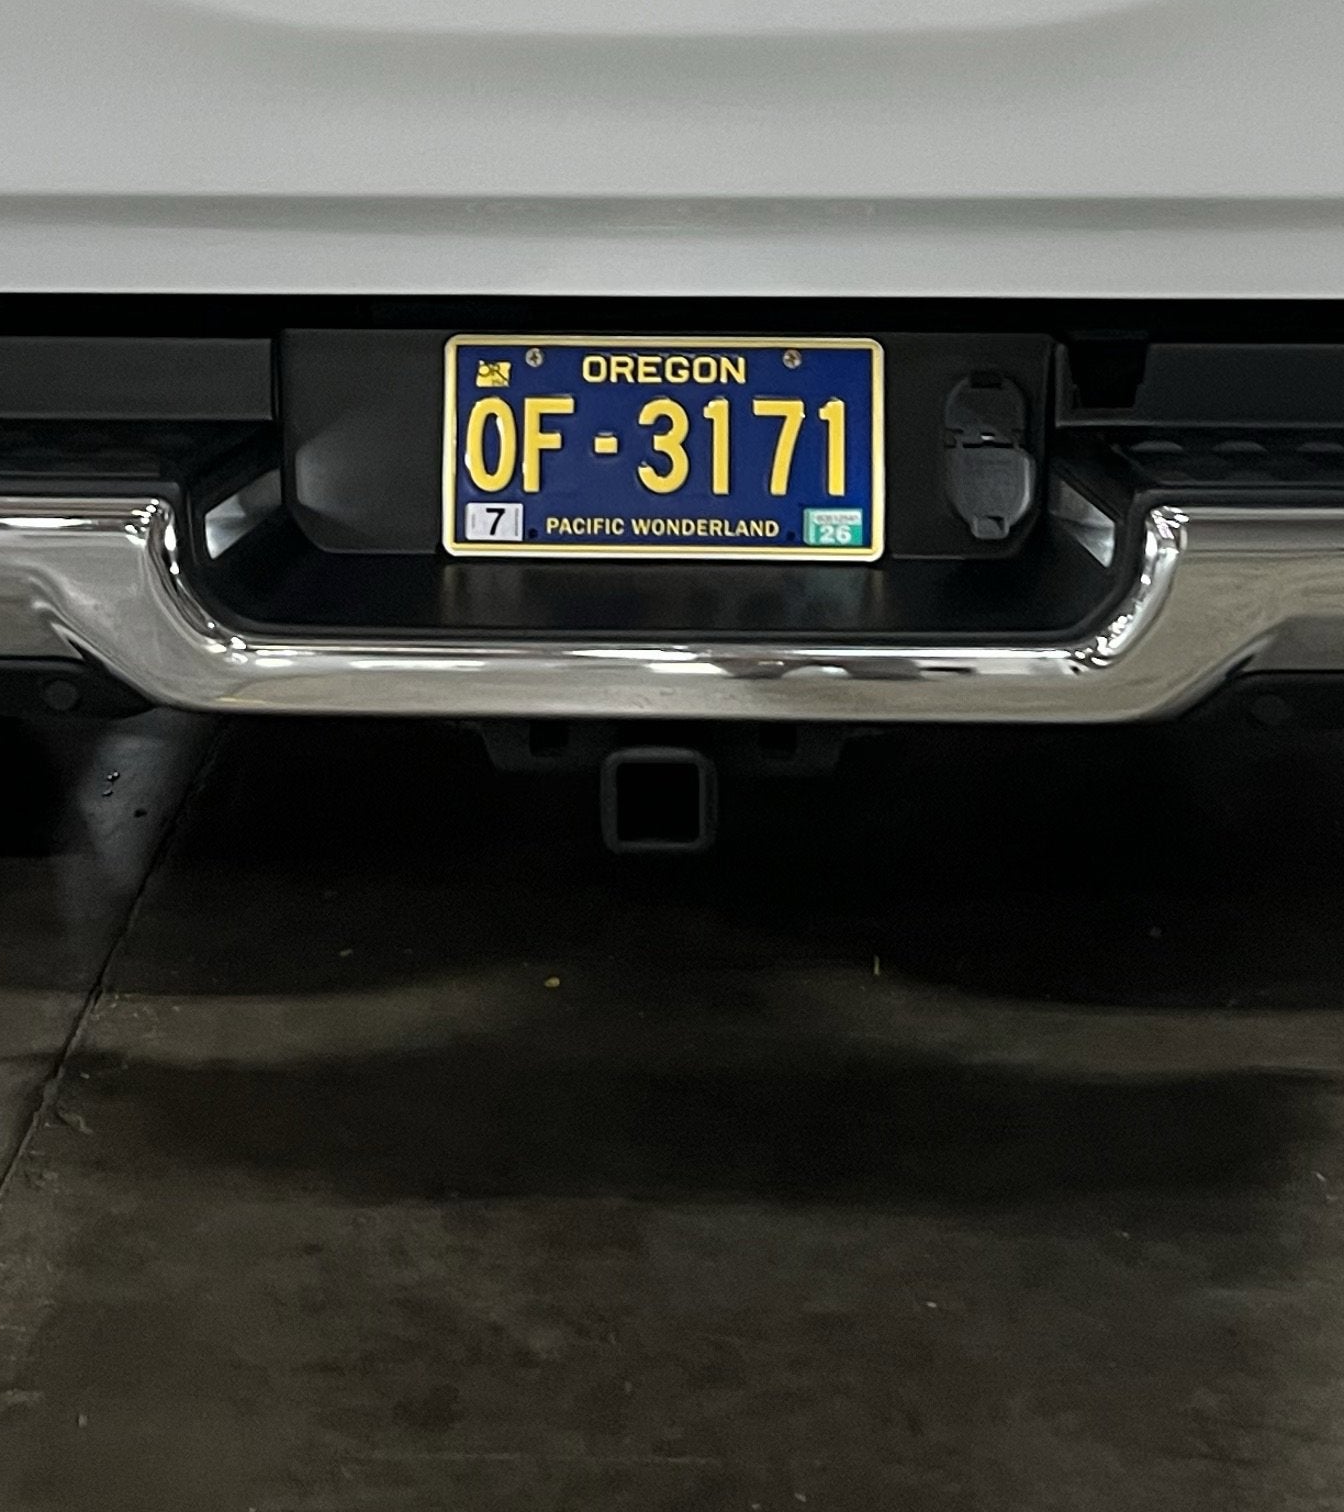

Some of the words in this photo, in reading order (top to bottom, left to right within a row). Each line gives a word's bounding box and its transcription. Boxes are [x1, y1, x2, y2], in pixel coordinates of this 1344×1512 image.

[582, 355, 746, 384] OREGON
[485, 508, 506, 536] 7
[545, 517, 625, 537] PACIFIC
[630, 517, 780, 538] WONDERLAND
[819, 524, 852, 544] 26
